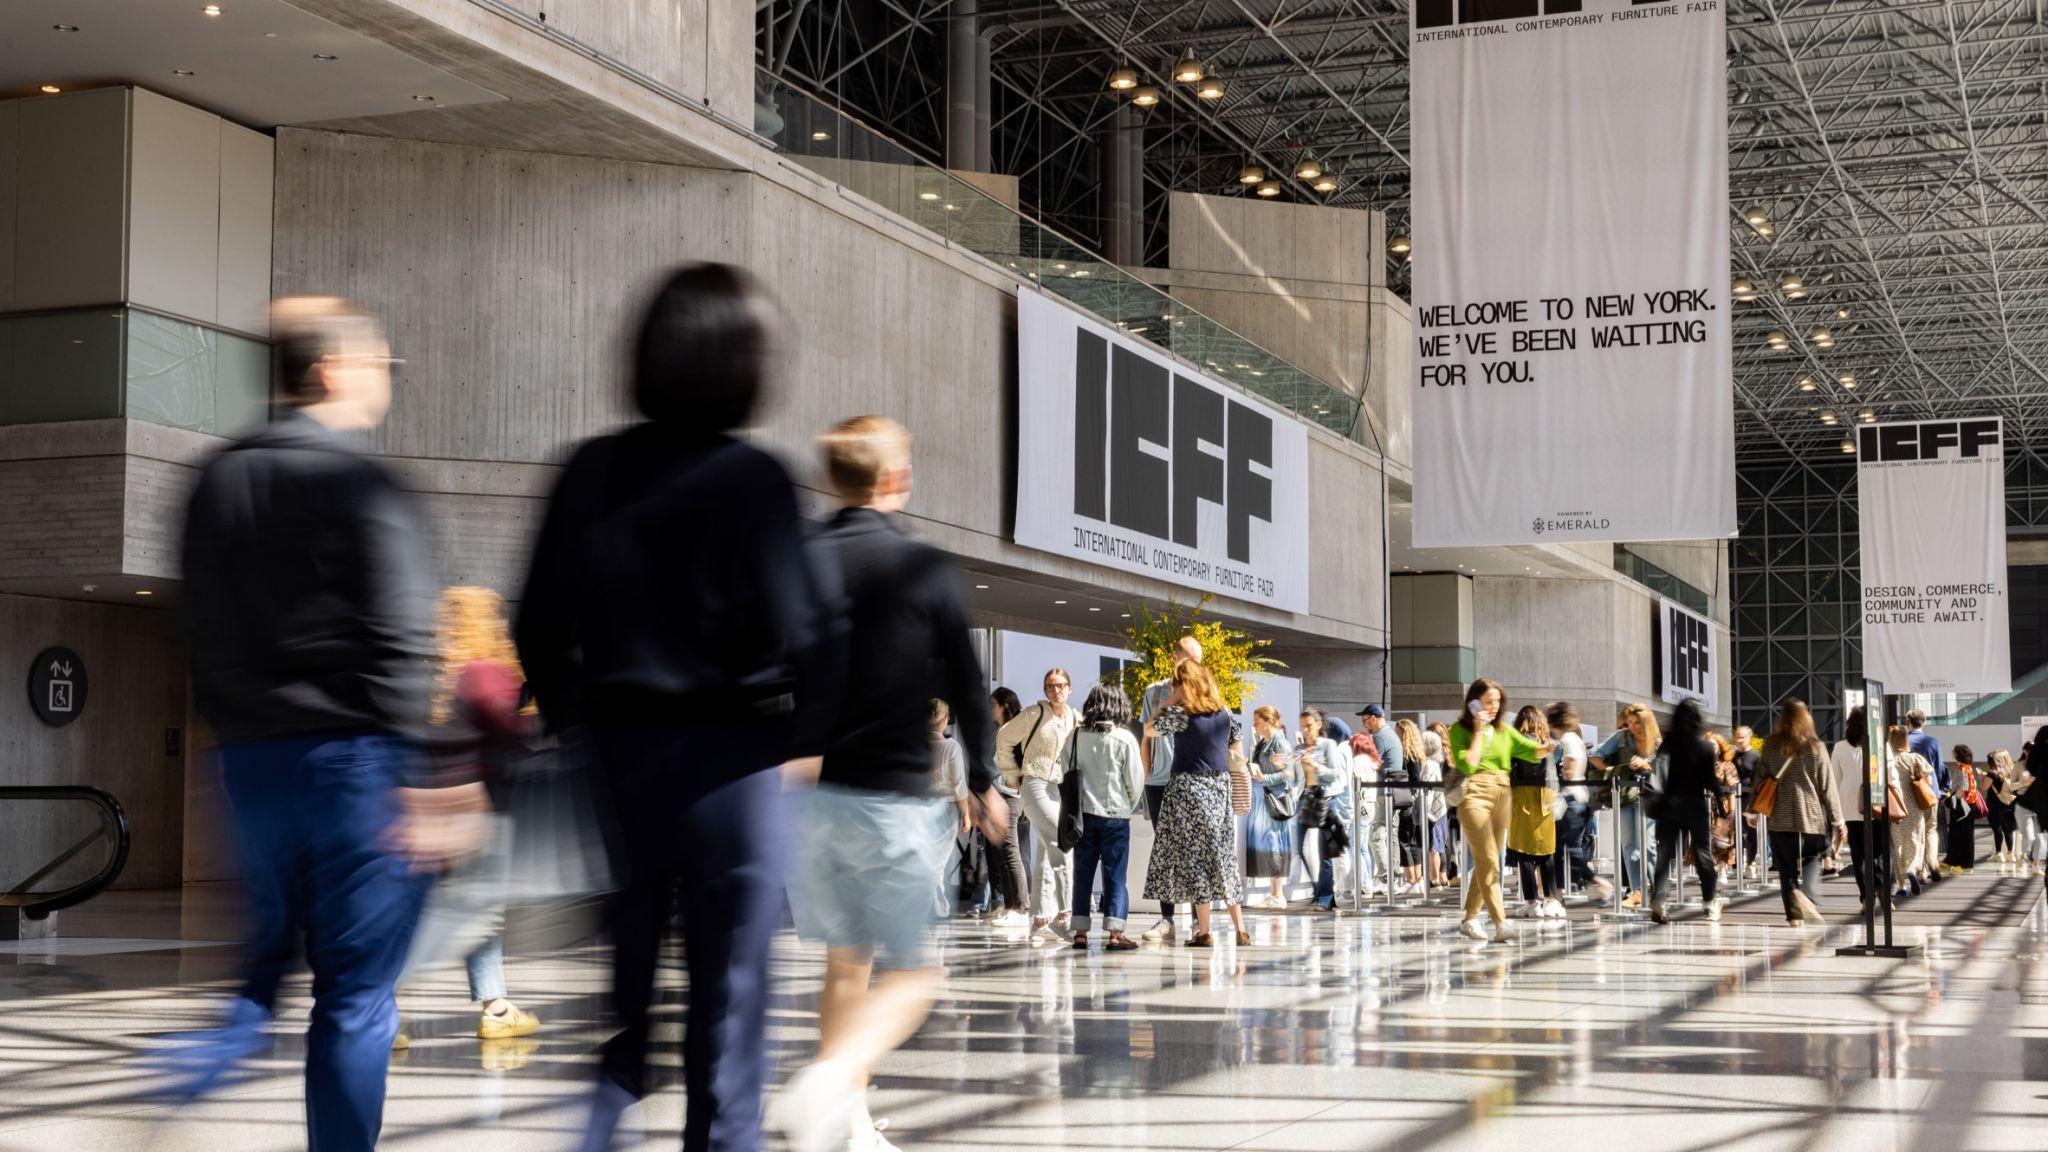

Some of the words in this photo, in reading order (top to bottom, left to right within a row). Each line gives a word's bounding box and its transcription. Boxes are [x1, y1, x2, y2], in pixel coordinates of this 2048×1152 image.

[1416, 24, 1509, 43] INTERNATIONAL
[1515, 14, 1604, 33] CONTEMPORARY
[1611, 5, 1679, 22] FURNITURE
[1686, 1, 1717, 13] FAIR
[1419, 300, 1528, 328] WELCOME
[1540, 297, 1574, 321] TO
[1585, 294, 1635, 319] NEW
[1644, 288, 1716, 315] YORK.
[1419, 332, 1498, 358] WE'VE
[1512, 328, 1576, 353] BEEN
[1591, 320, 1707, 349] WAITING
[1420, 364, 1466, 387] FOR
[1481, 360, 1535, 384] YOU.
[1074, 326, 1273, 565] ICFF
[1860, 420, 1999, 462] ICFF
[1860, 461, 1904, 469] INTERNATIONAL
[1907, 459, 1949, 467] CONTEMPORARY
[1547, 519, 1610, 531] EMERALD
[1073, 526, 1149, 566] INTERNATIONAL
[1153, 549, 1211, 581] CONTEMPORARY
[1215, 566, 1254, 594] FURNITURE
[1258, 578, 1274, 598] FAIR
[1865, 586, 1922, 598] DESIGN,
[1925, 583, 2002, 596] COMMERCE,
[1865, 599, 1942, 611] COMMUNITY
[1950, 598, 1977, 609] AND
[1865, 612, 1925, 625] CULTURE
[1933, 611, 1984, 622] AWAIT.
[1669, 606, 1709, 694] ICFF
